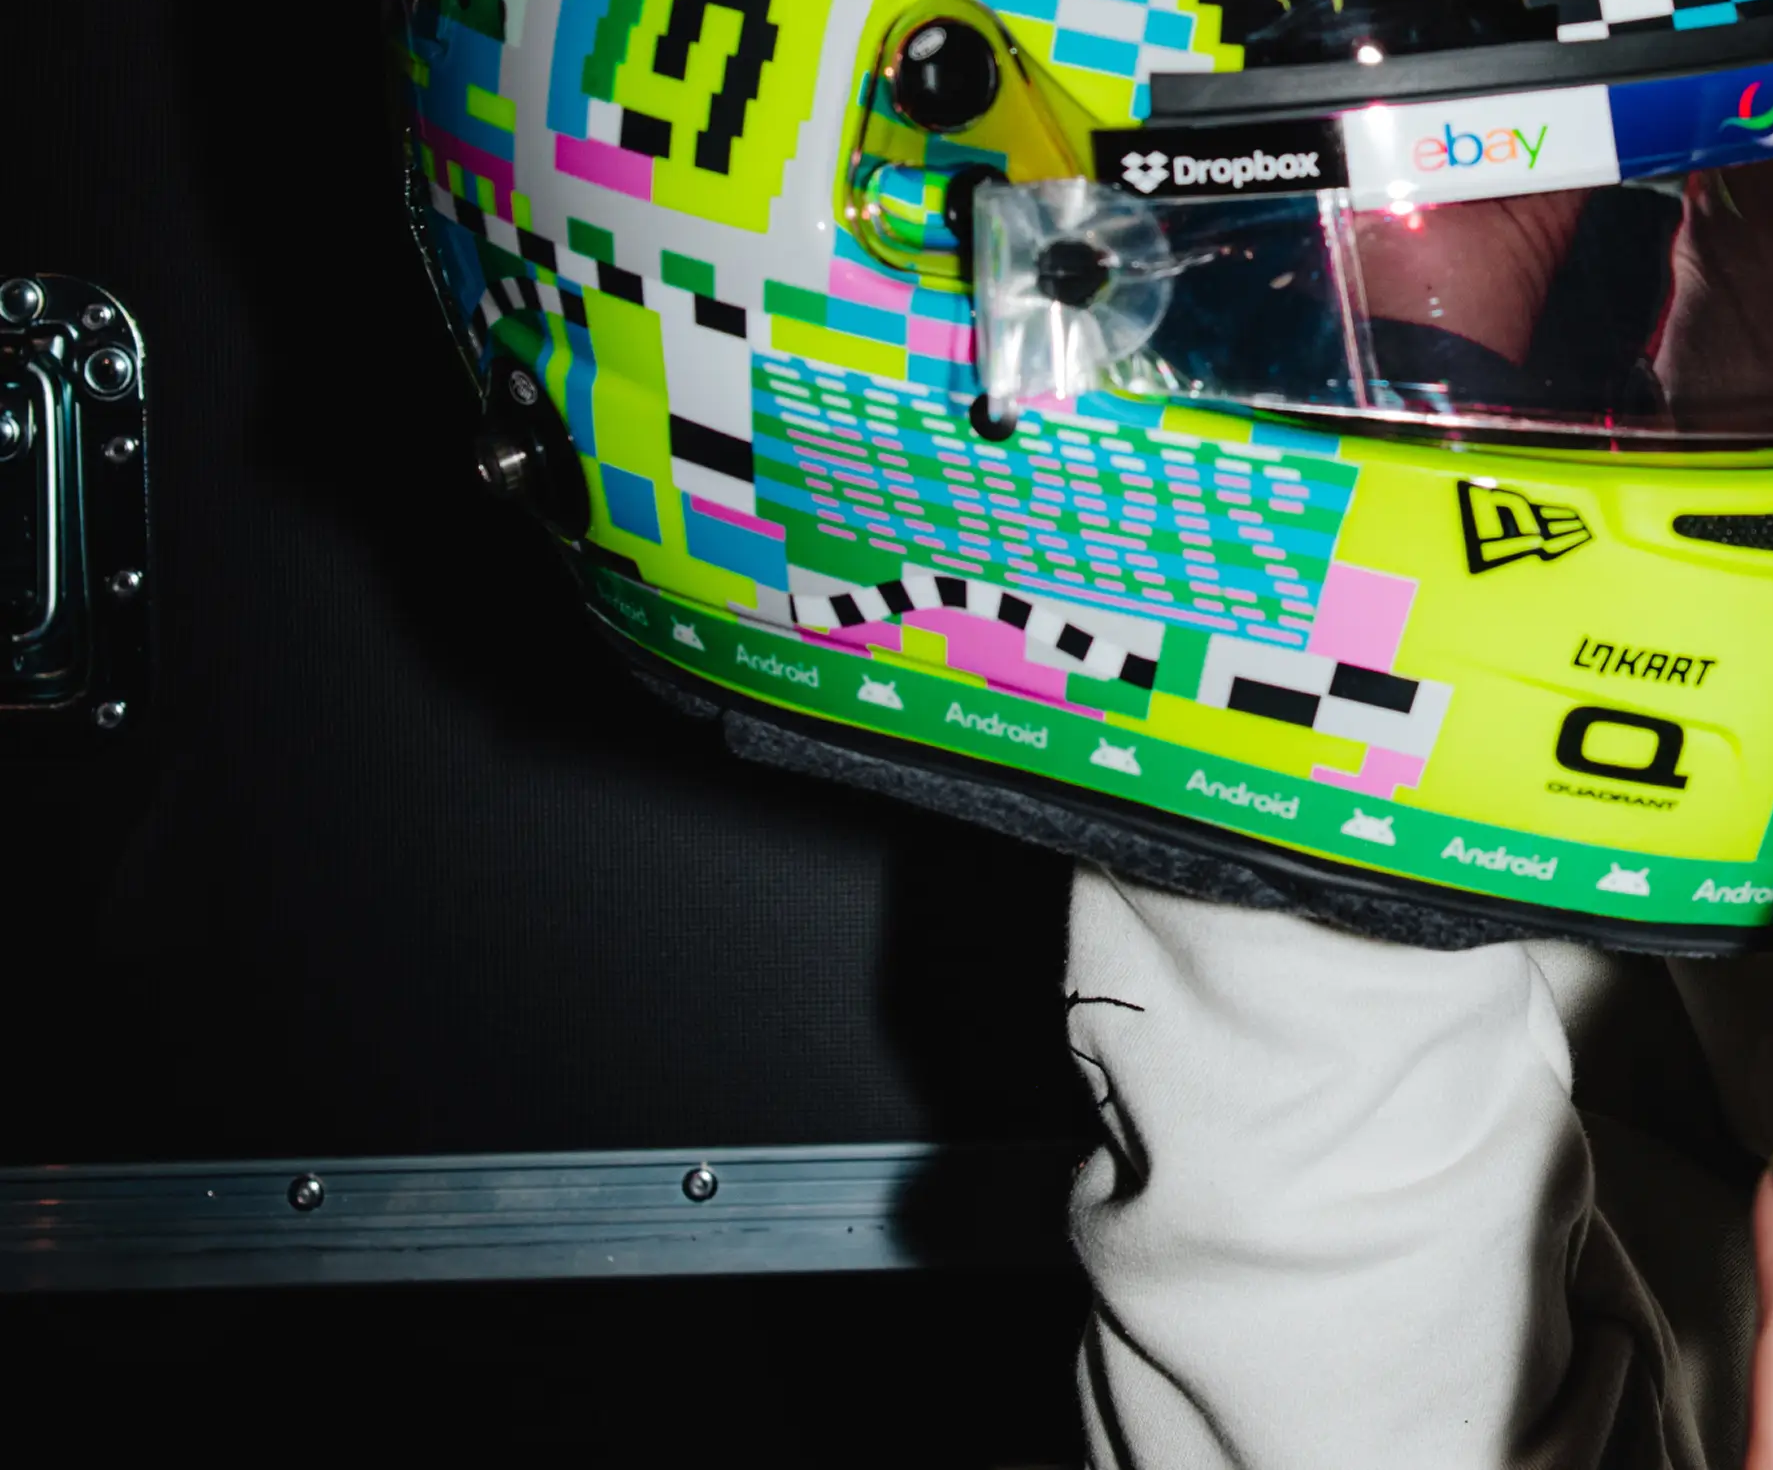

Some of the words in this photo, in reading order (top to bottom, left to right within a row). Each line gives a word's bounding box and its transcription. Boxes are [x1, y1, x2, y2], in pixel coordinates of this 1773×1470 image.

[1173, 149, 1320, 189] Dropbox
[1412, 123, 1548, 170] ebay
[736, 644, 820, 688] Android
[945, 702, 1048, 749] Android
[1186, 770, 1300, 820] Android
[1441, 837, 1558, 881] Android
[1555, 706, 1689, 790] Q
[1547, 781, 1678, 810] QUADRANT
